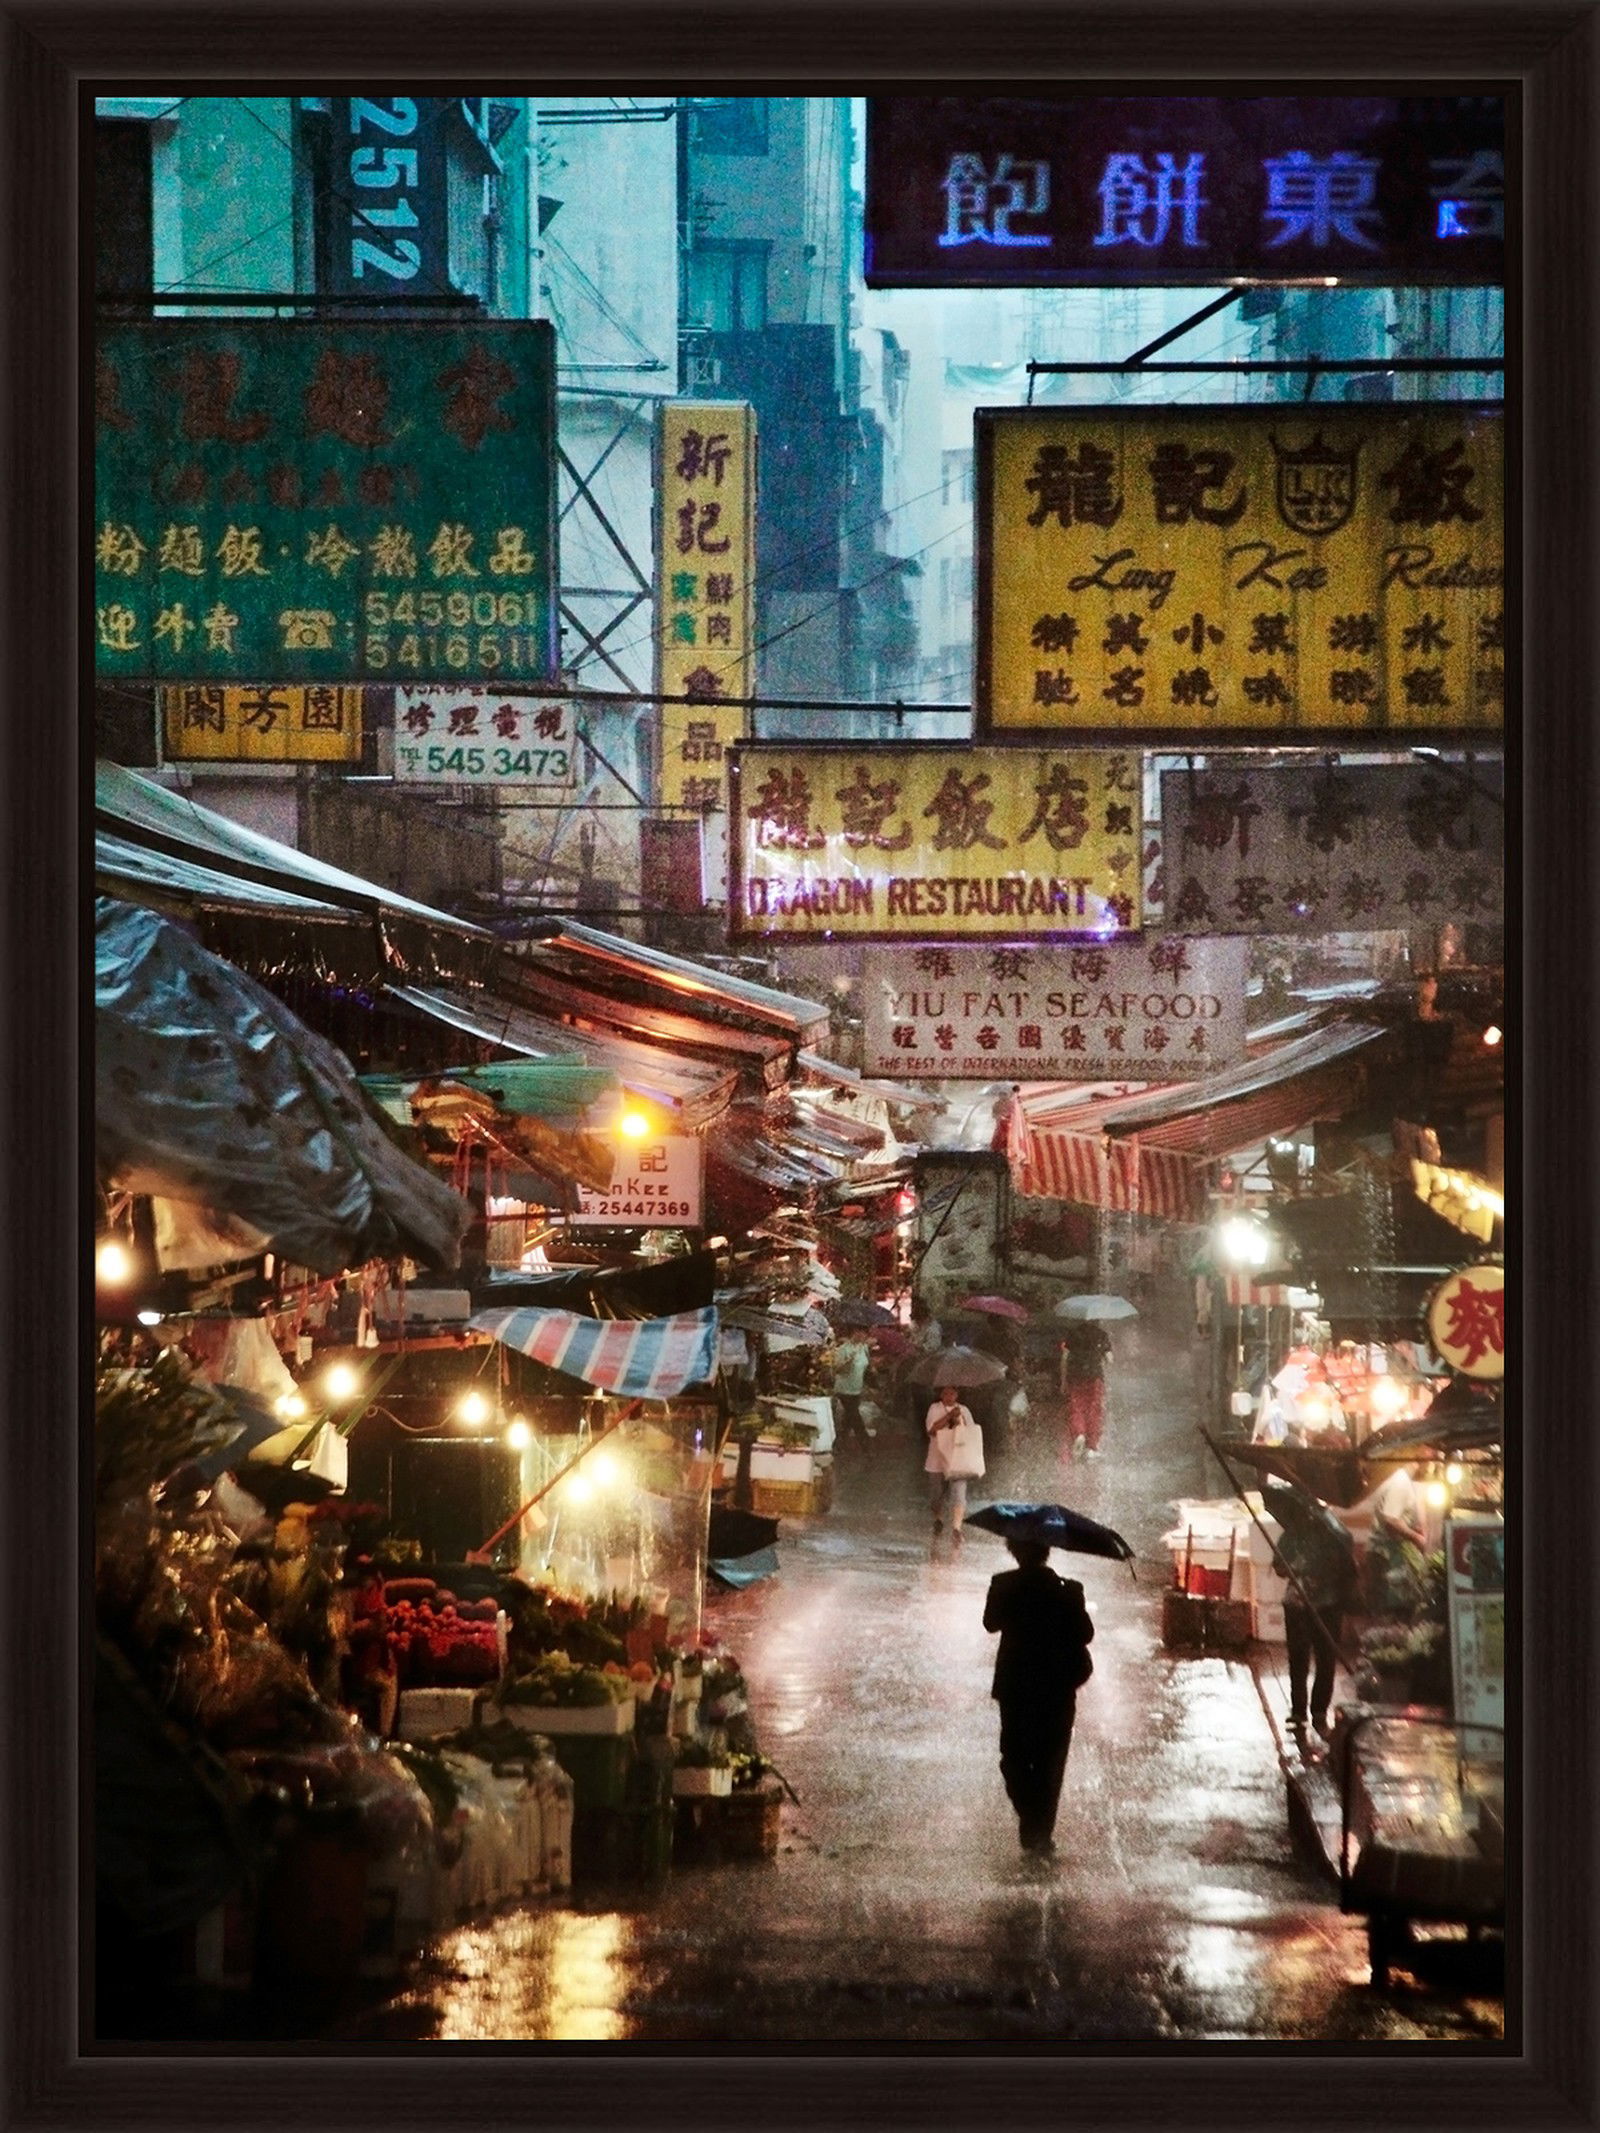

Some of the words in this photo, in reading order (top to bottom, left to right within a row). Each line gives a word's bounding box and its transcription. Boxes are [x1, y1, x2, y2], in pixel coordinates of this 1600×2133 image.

[676, 429, 732, 555] 新記
[1025, 443, 1247, 531] 龍記
[748, 877, 874, 917] DRAGON
[886, 877, 1093, 916] RESTAURANT
[962, 992, 1030, 1018] FAT
[1045, 991, 1223, 1019] SEAFOOD
[599, 1201, 690, 1216] 25447369
